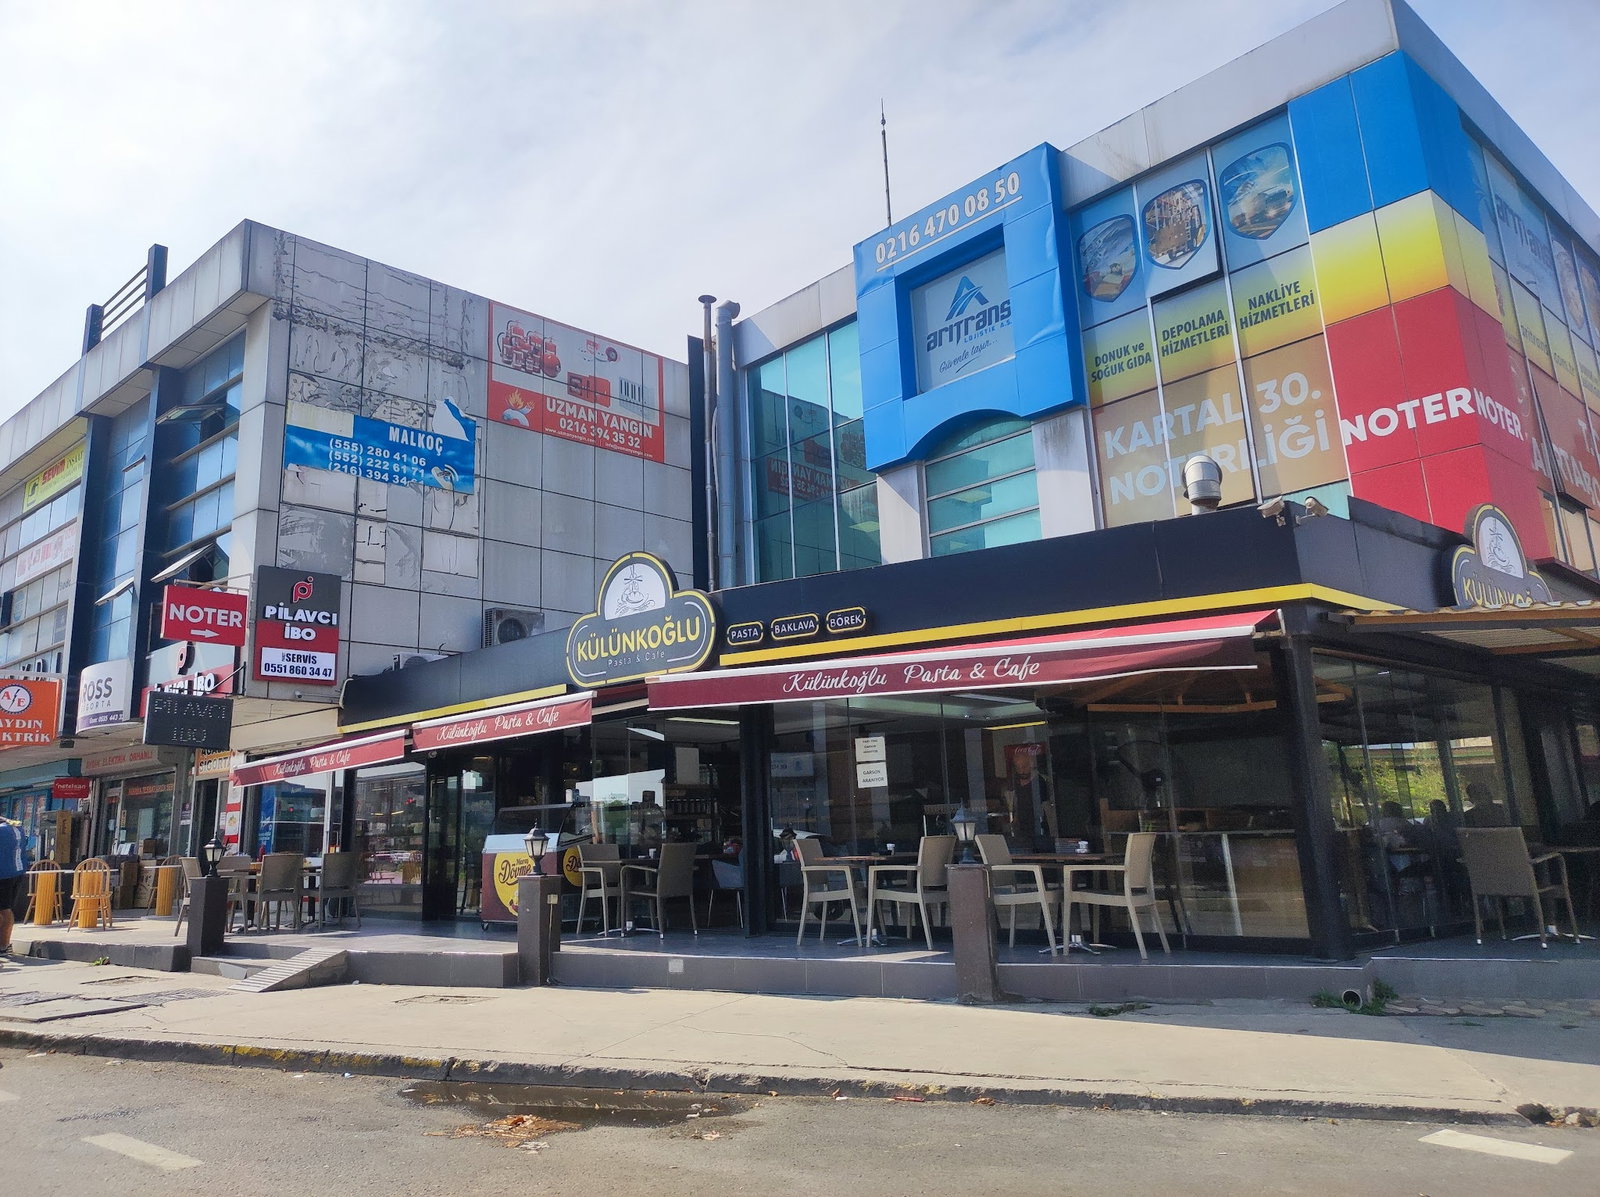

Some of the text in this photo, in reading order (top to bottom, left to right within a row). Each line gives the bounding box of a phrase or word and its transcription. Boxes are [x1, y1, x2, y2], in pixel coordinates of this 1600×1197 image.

[875, 171, 1020, 264] 0216 470 08 50
[1239, 290, 1315, 330] HİZMETLERİ
[1248, 281, 1301, 310] NAKLİYE
[1161, 309, 1226, 342] DEPOLAMA
[1161, 320, 1231, 358] HİZMETLERİ
[1091, 351, 1152, 383] SOĞUK GIDA
[1094, 341, 1145, 368] DONUK ve
[546, 397, 653, 438] UZMAN YANGIN
[1104, 372, 1322, 459] KARTAL 30.
[1340, 387, 1475, 446] NOTER
[1473, 388, 1525, 441] NOTER
[389, 426, 443, 456] MALKOÇ
[560, 418, 641, 449] 0216 394 35 32
[328, 450, 425, 478] (552) 222 61 71
[329, 438, 426, 467] (555) 280 41 06
[1109, 409, 1331, 506] NOTRLİĞİ
[328, 462, 362, 478] (216)
[366, 469, 390, 482] 394
[392, 475, 407, 486] 34
[169, 603, 243, 628] NOTER
[265, 602, 338, 625] PİLAVCI
[731, 614, 862, 640] PASTA BAKLAVA BÖREK
[284, 622, 316, 641] İBO
[577, 615, 700, 662] KÜLÜNKOĞLU
[264, 662, 333, 678] 0551 860 34 47
[285, 653, 317, 665] SERVİS
[608, 651, 665, 667] Pasta & Cafe
[783, 656, 1040, 694] Külünkoğlu Pasta & Cafe
[437, 705, 559, 741] Külünkoğlu Pasta & Cafe
[329, 753, 335, 765] &
[336, 749, 351, 765] Cafe
